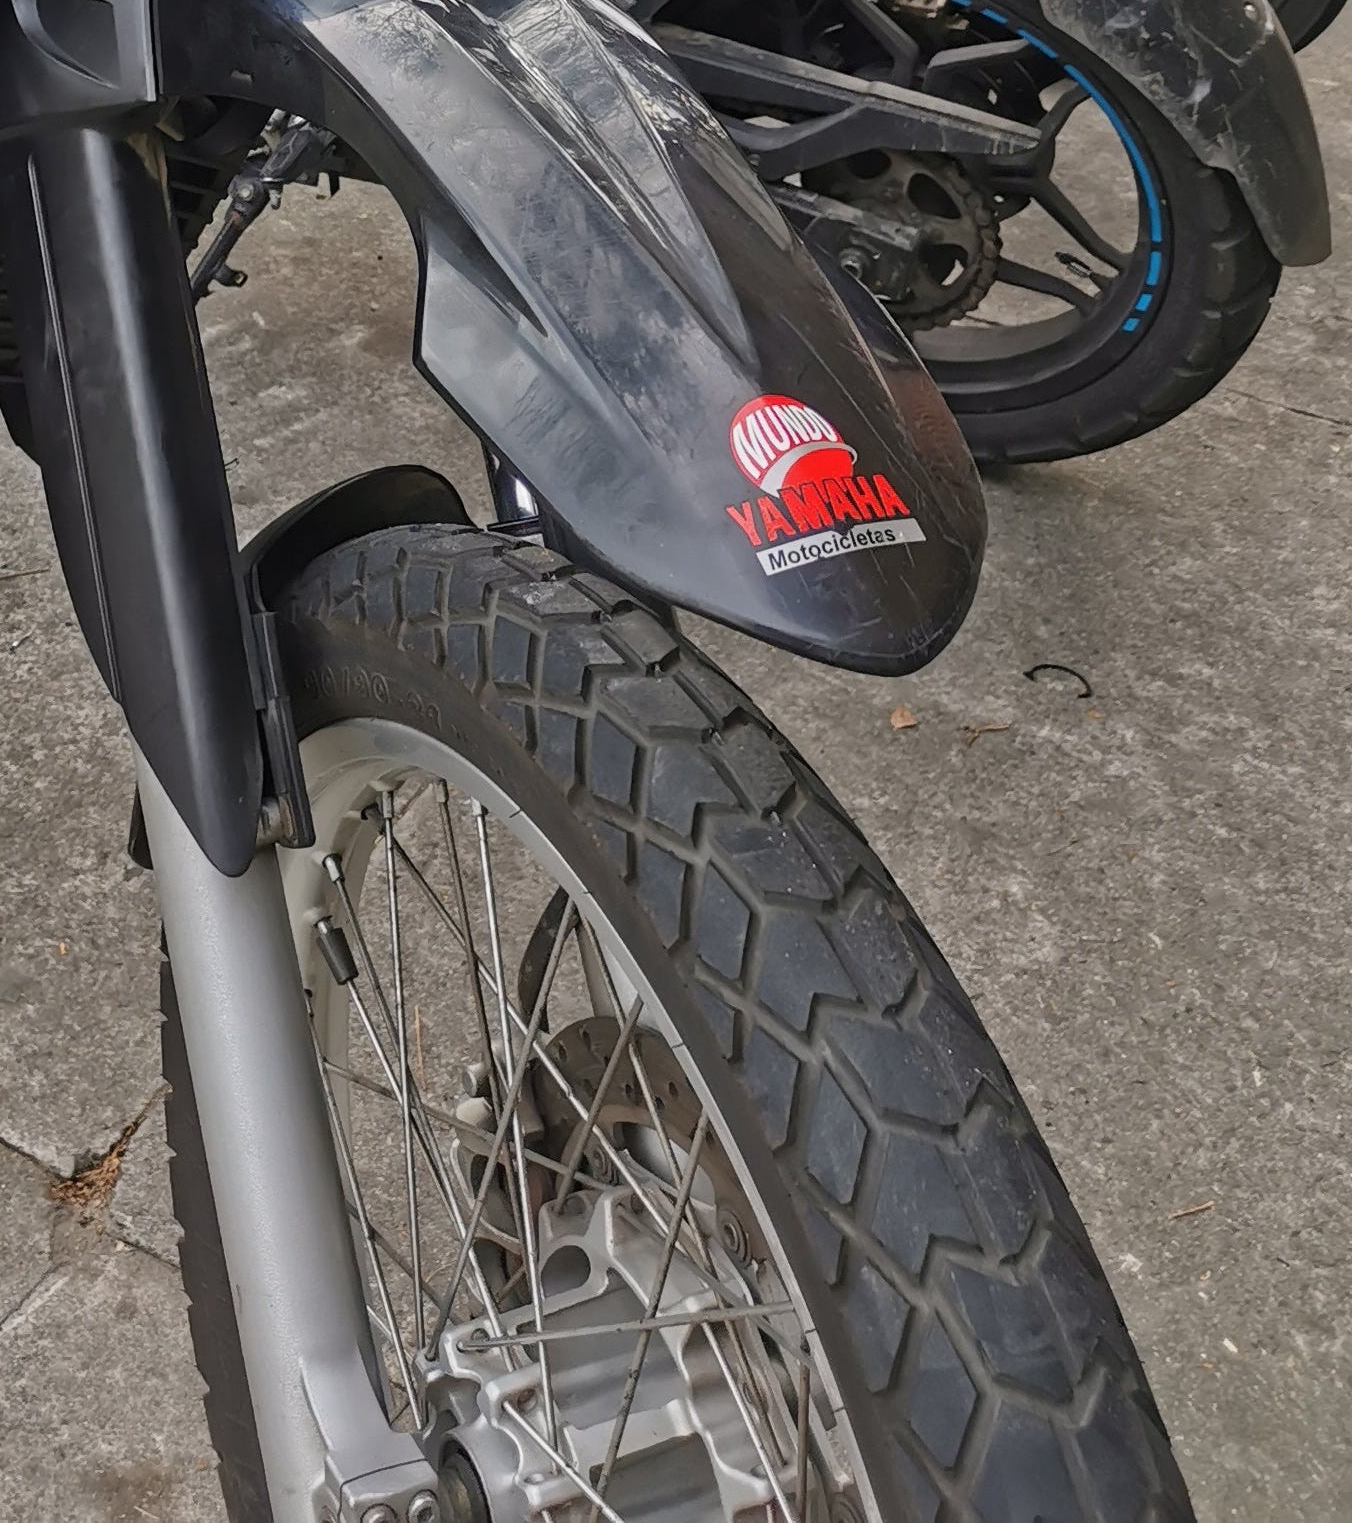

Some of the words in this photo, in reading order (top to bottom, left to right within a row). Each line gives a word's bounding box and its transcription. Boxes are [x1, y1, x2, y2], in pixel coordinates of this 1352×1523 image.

[732, 404, 838, 479] MUNDO
[726, 474, 910, 547] YAMAHA
[768, 527, 896, 571] Motocicletas
